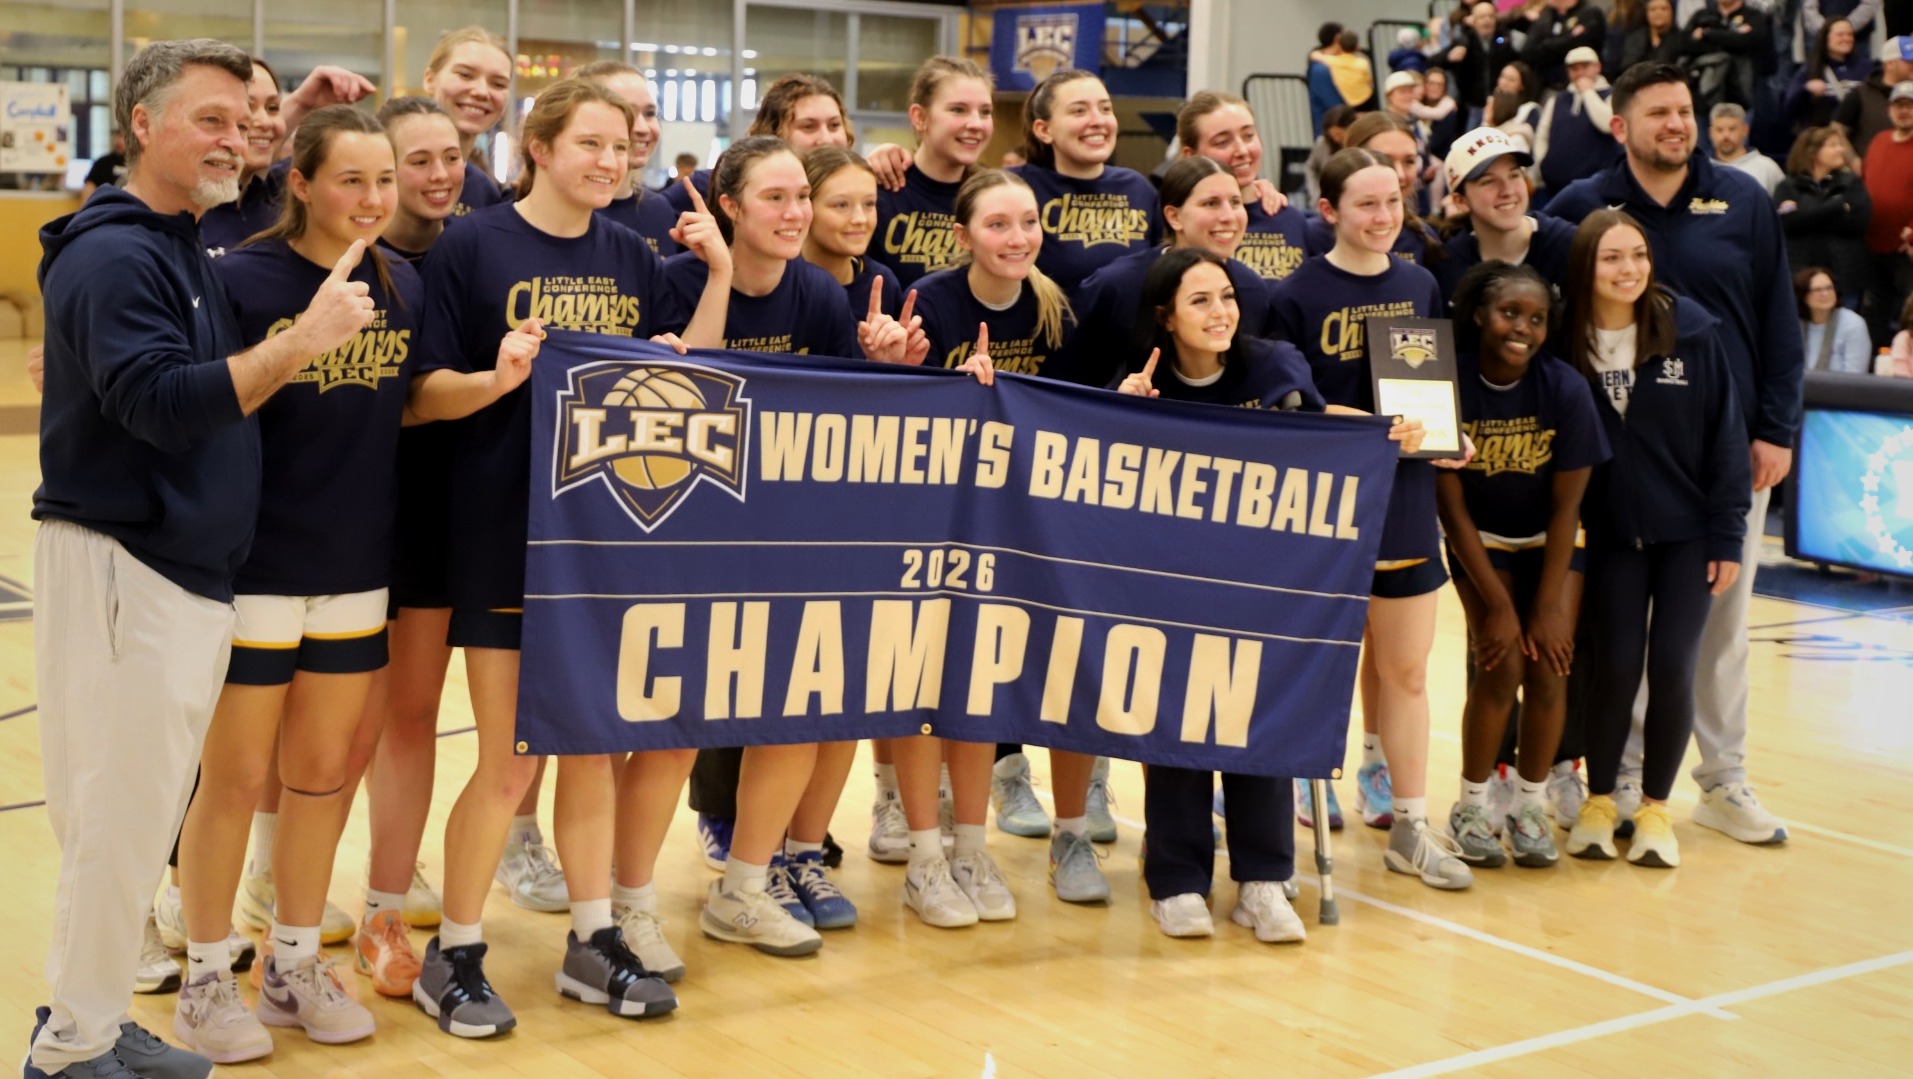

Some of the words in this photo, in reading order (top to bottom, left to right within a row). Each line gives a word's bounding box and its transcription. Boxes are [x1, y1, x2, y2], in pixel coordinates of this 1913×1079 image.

[921, 212, 956, 221] LITTLE
[1041, 193, 1148, 234] Champs
[918, 220, 954, 228] CONFE
[1231, 246, 1304, 269] amps
[543, 284, 618, 293] CONFERENCE
[545, 276, 584, 285] LITTLE
[588, 276, 615, 285] EAST
[506, 276, 640, 330] Champs
[1351, 303, 1386, 314] LITTLE
[1388, 301, 1414, 311] EAST
[1350, 308, 1416, 321] COFERENCE
[731, 338, 767, 348] LITTLE
[769, 333, 792, 345] EAST
[1393, 333, 1434, 351] LEC
[322, 366, 374, 386] LEC
[1516, 416, 1537, 425] EAS
[570, 408, 736, 469] LEC
[760, 410, 1015, 489] WOMEN'S
[1028, 430, 1360, 541] BASKETBALL
[900, 549, 997, 592] 2026
[616, 598, 1263, 749] CHAMPION
